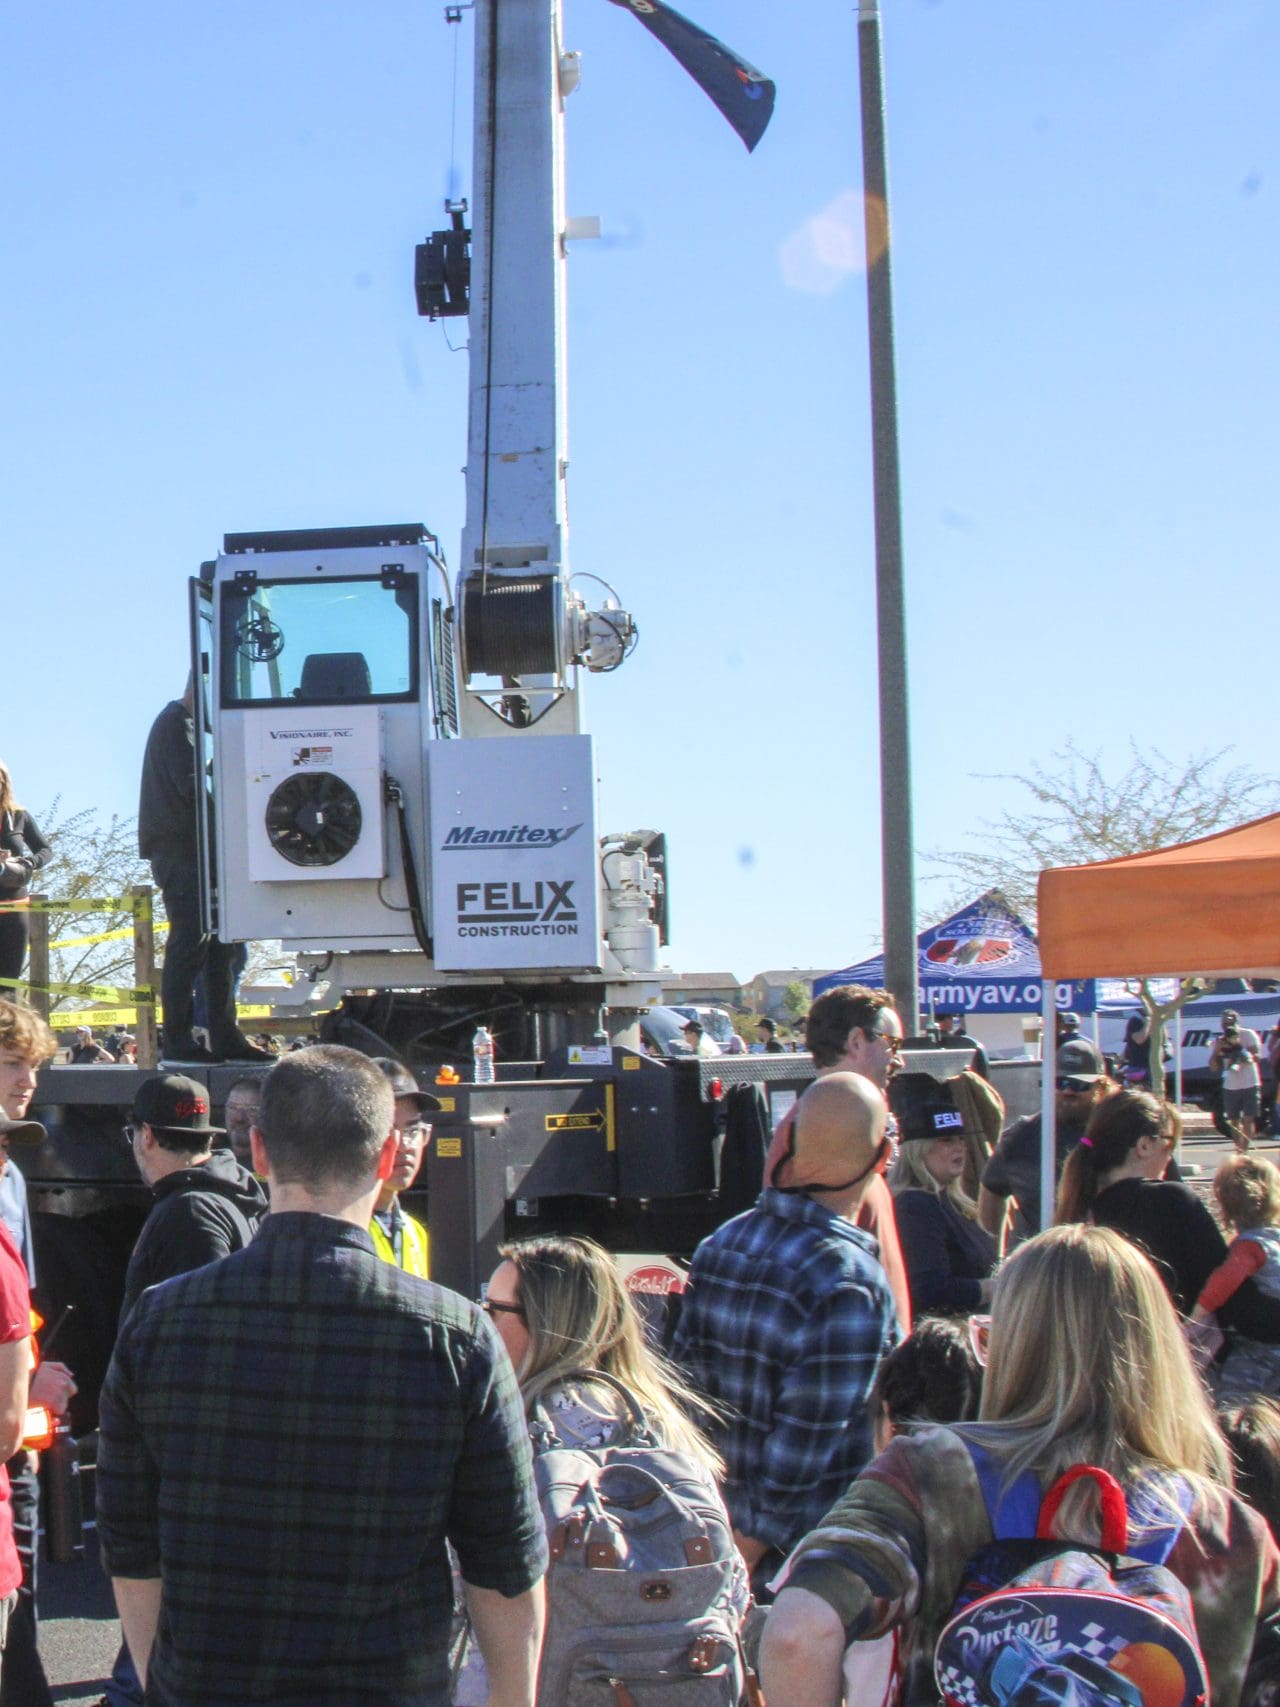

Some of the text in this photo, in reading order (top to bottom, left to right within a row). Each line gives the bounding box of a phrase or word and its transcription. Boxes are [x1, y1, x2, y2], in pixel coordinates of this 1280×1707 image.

[445, 824, 564, 844] Manitex
[457, 881, 576, 921] FELIX
[458, 925, 578, 937] CONSTRUCTION
[917, 983, 1073, 1010] armyav.og
